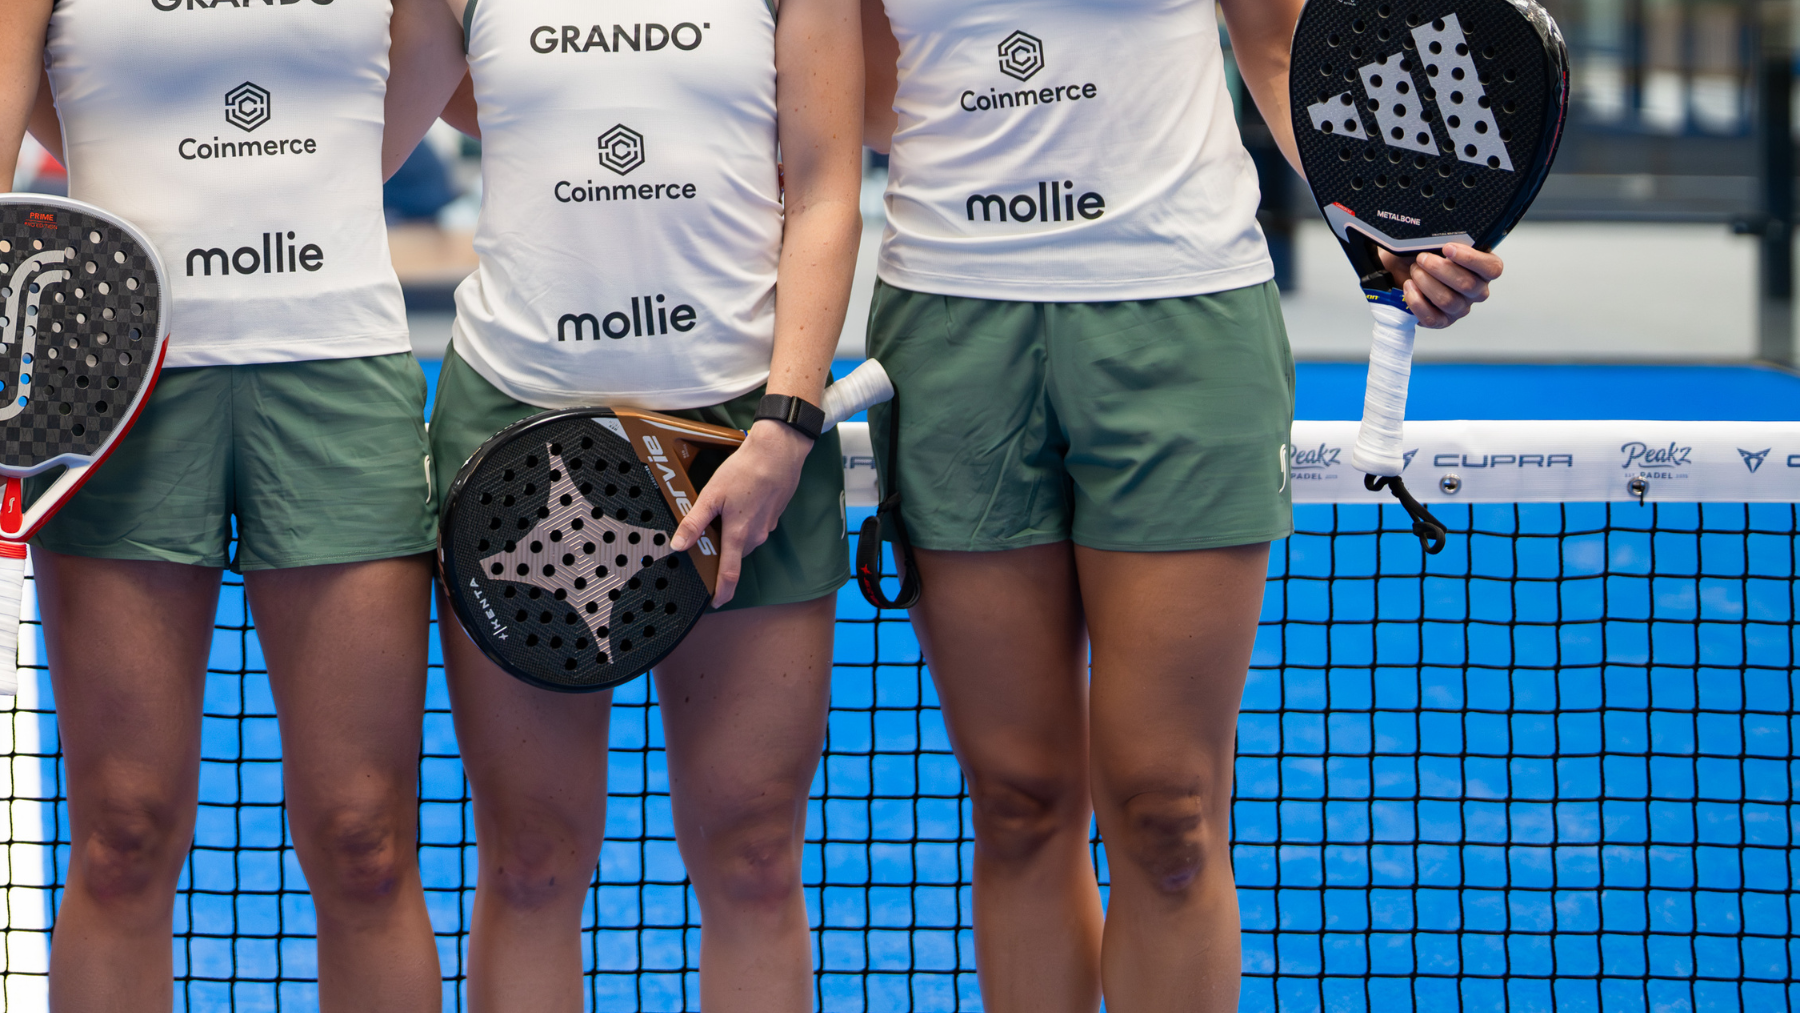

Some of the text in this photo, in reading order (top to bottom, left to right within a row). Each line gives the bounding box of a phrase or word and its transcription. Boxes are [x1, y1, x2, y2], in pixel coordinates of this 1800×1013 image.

[530, 22, 702, 54] GRANDO
[960, 82, 1097, 112] Coinmerce
[178, 136, 317, 160] Coinmerce
[554, 179, 697, 203] Coinmerce
[966, 180, 1106, 223] mollie
[29, 211, 55, 222] PRIME
[1377, 210, 1421, 226] METALBONE
[186, 231, 324, 277] mollie
[557, 293, 697, 342] mollie
[1433, 453, 1574, 468] CUPRA
[1620, 441, 1693, 469] Peakz
[1640, 471, 1674, 479] PADEL
